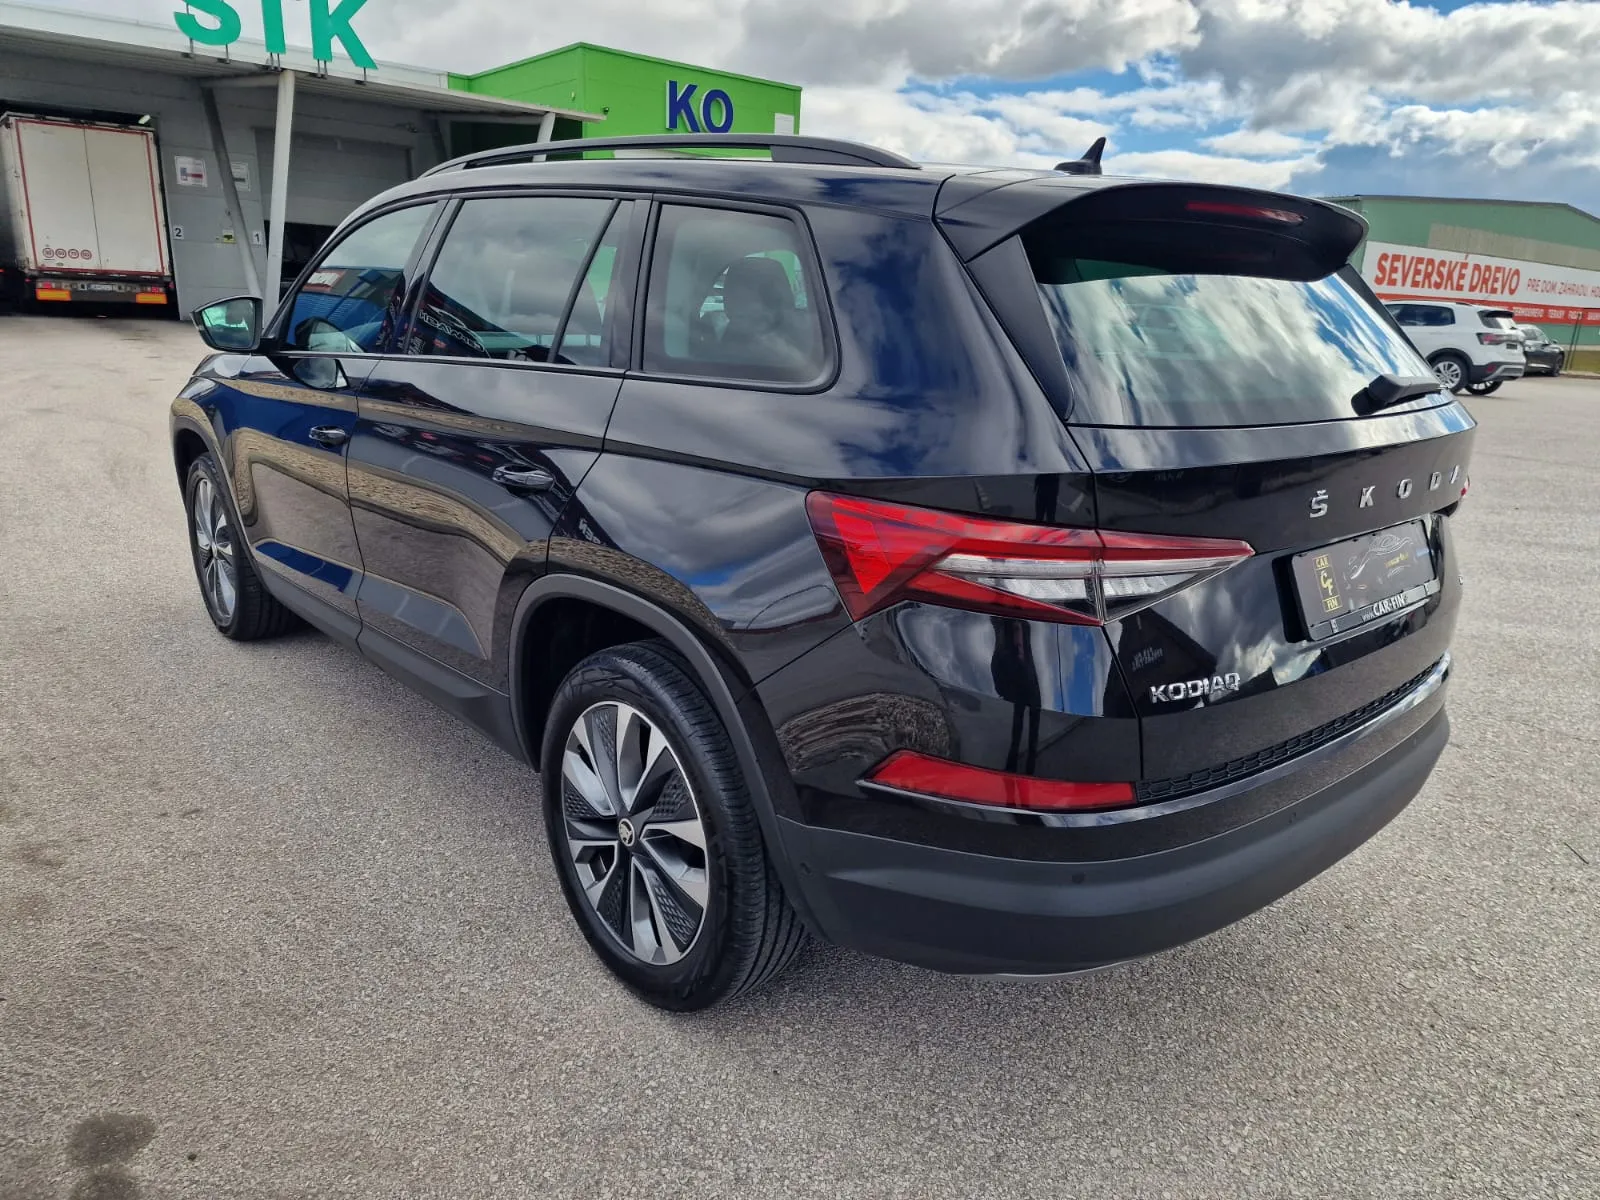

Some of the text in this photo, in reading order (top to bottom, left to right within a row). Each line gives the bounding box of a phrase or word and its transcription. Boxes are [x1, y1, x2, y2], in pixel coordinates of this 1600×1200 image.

[666, 80, 734, 134] KO
[174, 227, 183, 238] 2
[254, 232, 261, 243] 1
[1374, 252, 1469, 292] SEVERSKÉ
[1468, 263, 1521, 296] DREVO
[1150, 672, 1241, 704] KODIAQ
